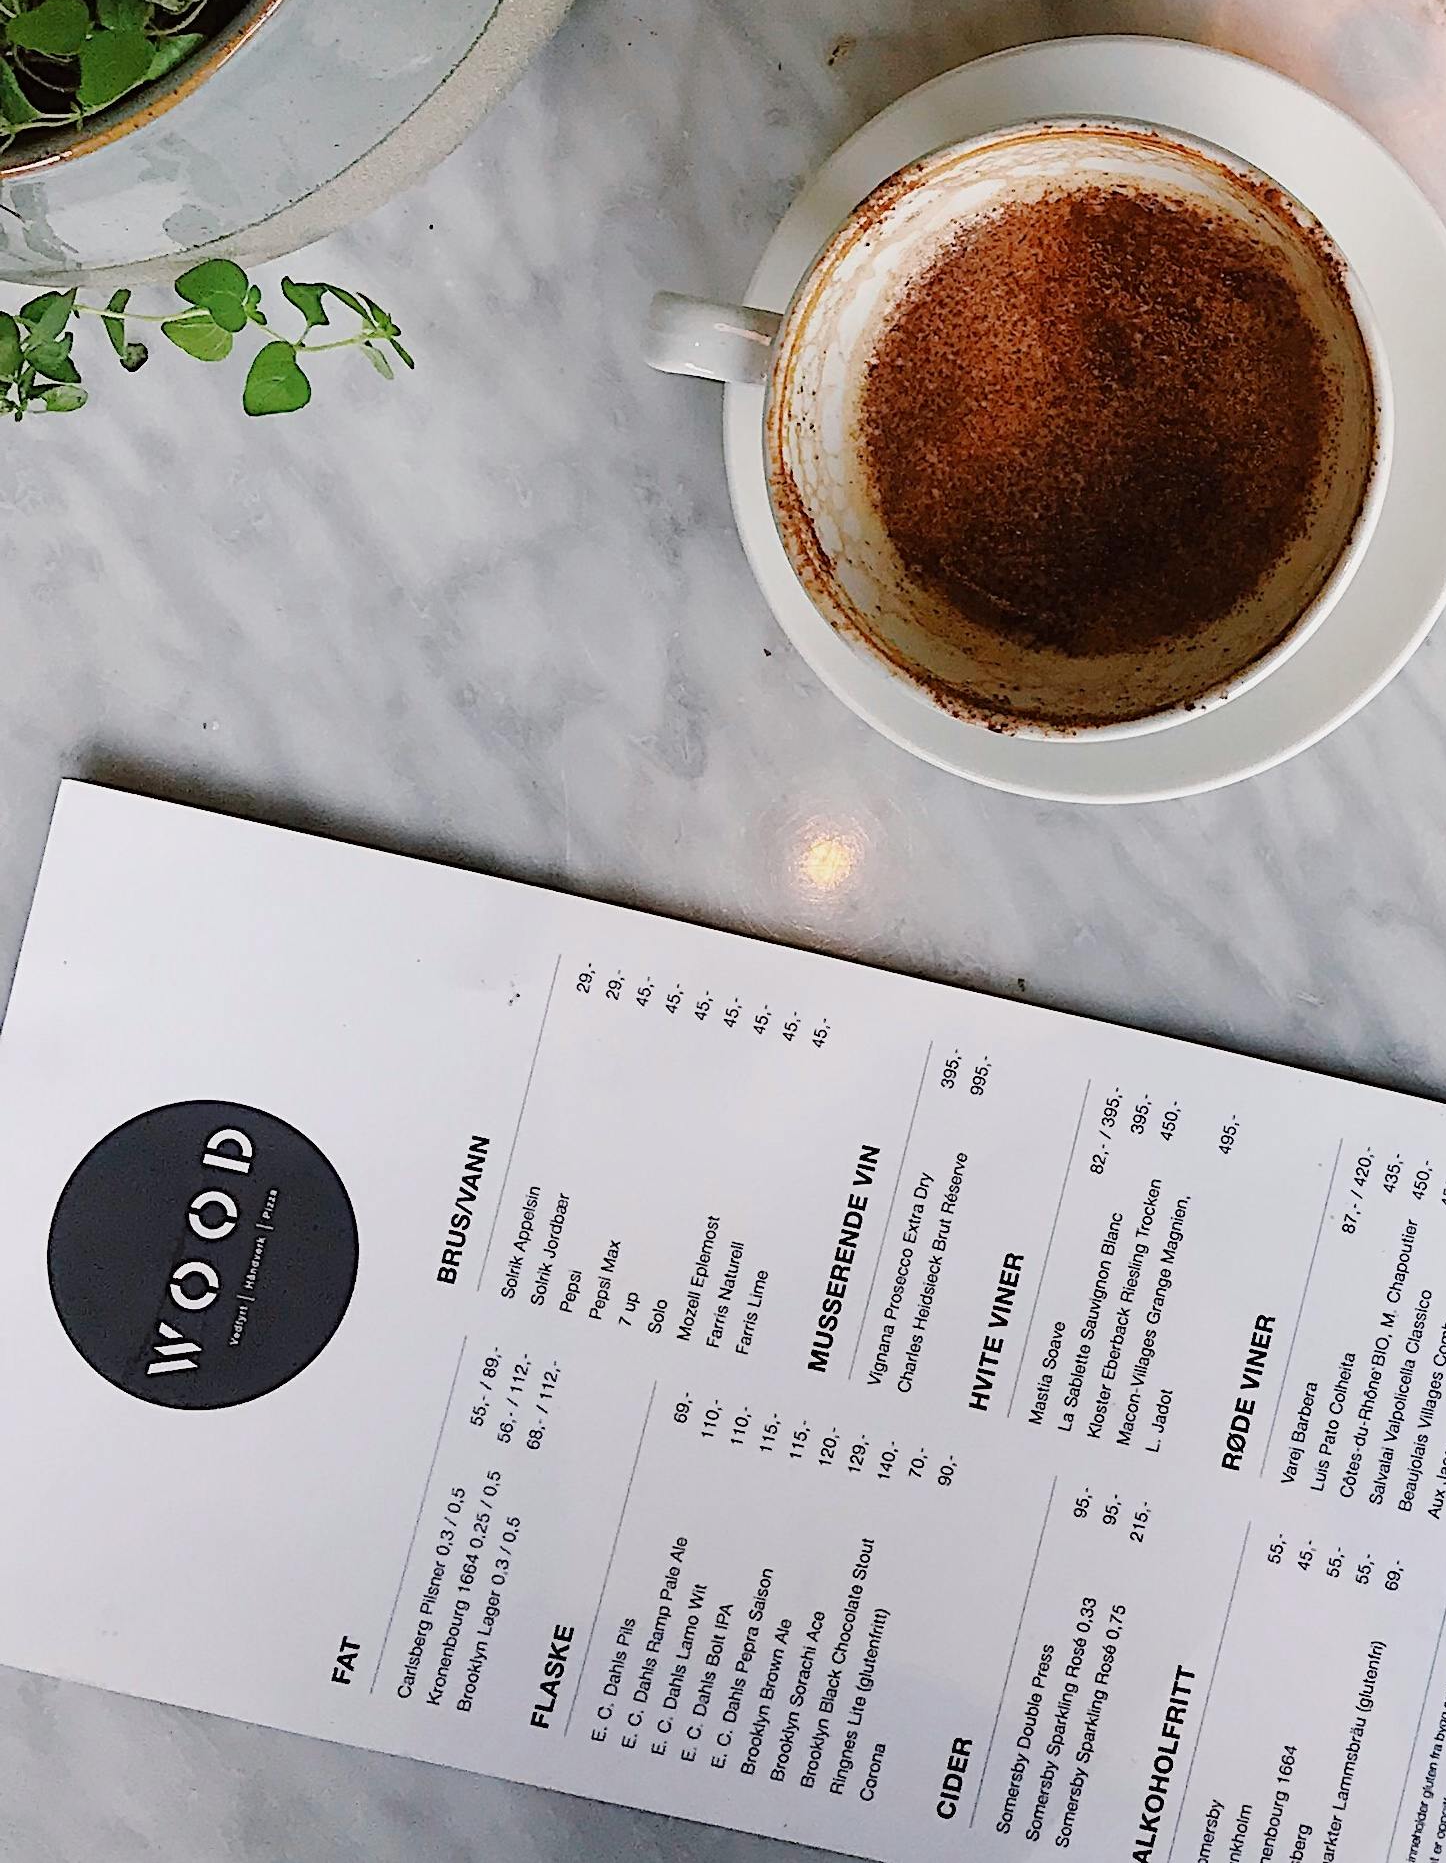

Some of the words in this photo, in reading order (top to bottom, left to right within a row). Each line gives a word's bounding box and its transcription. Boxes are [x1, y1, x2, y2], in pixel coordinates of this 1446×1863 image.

[940, 1048, 962, 1089] 395,-
[970, 1055, 992, 1096] 995,-
[500, 1255, 524, 1299] Solrik
[513, 1186, 541, 1253] Appelsin
[576, 962, 596, 994] 29,-
[559, 1269, 582, 1313] Pepsi
[635, 976, 655, 1007] 45,-
[1353, 1146, 1375, 1187] 420,-
[1383, 1153, 1404, 1194] 435,-
[262, 1190, 277, 1219] Pizza
[436, 1135, 490, 1285] BRUS/VANN
[542, 1192, 570, 1259] Jordbær
[902, 1203, 925, 1244] Extra
[913, 1172, 935, 1200] Dry
[940, 1152, 968, 1215] Réserve
[1341, 1203, 1362, 1235] 87,-
[147, 1129, 252, 1374] WOOD
[600, 1239, 621, 1273] Max
[676, 1291, 701, 1341] Mozell
[690, 1215, 720, 1288] Eplemost
[807, 1193, 869, 1373] MUSSERENDE
[852, 1144, 881, 1186] VIN
[931, 1218, 952, 1252] Brut
[1086, 1383, 1115, 1439] Kloster
[1101, 1307, 1131, 1380] Eberback
[1120, 1243, 1150, 1303] Riesling
[1135, 1178, 1162, 1238] Trocken
[1160, 1101, 1182, 1142] 450,-
[1151, 1389, 1173, 1434] Jadot
[1218, 1114, 1240, 1155] 495,-
[647, 1299, 668, 1334] Solo
[705, 1305, 729, 1348] Farris
[717, 1241, 744, 1301] Naturell
[747, 1270, 769, 1308] Lime
[883, 1248, 914, 1321] Prosecco
[911, 1255, 943, 1331] Heidsieck
[1028, 1374, 1053, 1425] Mastia
[1042, 1321, 1066, 1370] Soave
[1089, 1143, 1109, 1175] 82,-
[1063, 1344, 1091, 1408] Sablette
[1080, 1260, 1112, 1341] Sauvignon
[1100, 1212, 1123, 1256] Blanc
[1116, 1329, 1157, 1446] Macon-Villages
[1146, 1268, 1173, 1325] Grange
[1160, 1196, 1192, 1264] Magnien,
[1371, 1334, 1393, 1367] BIO,
[1386, 1218, 1418, 1304] Chapoutier
[866, 1324, 895, 1385] Vignana
[897, 1334, 924, 1393] Charles
[968, 1335, 1004, 1412] HVITE
[987, 1252, 1025, 1328] VINER
[1383, 1359, 1416, 1442] Valpolicella
[1405, 1289, 1432, 1354] Classico
[1221, 1397, 1256, 1471] RØDE
[1239, 1314, 1276, 1390] VINER
[1290, 1381, 1318, 1443] Barbera
[1329, 1352, 1356, 1415] Colheita
[759, 1413, 782, 1452] 115,-
[908, 1447, 928, 1478] 70,-
[1280, 1446, 1305, 1484] Varej
[1310, 1460, 1330, 1492] Luis
[1318, 1419, 1340, 1456] Pato
[1397, 1434, 1429, 1512] Beaujolais
[1417, 1371, 1444, 1429] Villages
[397, 1619, 434, 1699] Carlsberg
[419, 1560, 446, 1615] Pilsner
[436, 1529, 455, 1556] 0,3
[447, 1487, 466, 1514] 0,5
[469, 1395, 490, 1427] 55,-
[482, 1347, 502, 1379] 89,-
[426, 1599, 471, 1706] Kronenbourg
[457, 1554, 480, 1592] 1664
[469, 1513, 490, 1549] 0,25
[496, 1412, 518, 1444] 56,-
[509, 1353, 532, 1392] 112,-
[456, 1641, 488, 1713] Brooklyn
[476, 1589, 501, 1636] Lager
[526, 1419, 546, 1450] 68,-
[602, 1651, 627, 1697] Dahls
[616, 1618, 636, 1647] Pils
[673, 1392, 693, 1424] 69,-
[645, 1605, 672, 1653] Ramp
[670, 1537, 688, 1564] Ale
[701, 1399, 723, 1437] 110,-
[1297, 1540, 1317, 1571] 45,-
[714, 1604, 734, 1630] IPA
[740, 1704, 771, 1776] Brooklyn
[759, 1648, 785, 1702] Brown
[818, 1427, 840, 1466] 120,-
[789, 1645, 817, 1708] Sorachi
[847, 1434, 870, 1473] 129,-
[818, 1669, 843, 1714] Black
[831, 1584, 864, 1665] Chocolate
[852, 1538, 875, 1581] Stout
[877, 1441, 899, 1479] 140,-
[1105, 1604, 1126, 1640] 0,75
[1129, 1501, 1152, 1543] 215,-
[331, 1635, 361, 1685] FAT
[705, 1634, 726, 1667] Bolt
[735, 1626, 760, 1674] Pepra
[748, 1568, 774, 1622] Saison
[855, 1608, 891, 1692] (glutenfritt)
[859, 1743, 886, 1802] Corona
[937, 1455, 958, 1487] 90,-
[995, 1751, 1030, 1835] Somersby
[1016, 1692, 1043, 1750] Double
[1031, 1644, 1055, 1689] Press
[1073, 1487, 1093, 1518] 95,-
[529, 1624, 575, 1729] FLASKE
[846, 1696, 867, 1726] Lite
[1025, 1760, 1060, 1842] Somersby
[1046, 1682, 1079, 1757] Sparkling
[1065, 1637, 1087, 1679] Rosé
[1076, 1597, 1097, 1633] 0,33
[1331, 1716, 1367, 1811] Lammsbräu
[1355, 1641, 1387, 1713] (glutenfri)
[1384, 1560, 1404, 1591] 69,-
[829, 1730, 858, 1795] Ringnes
[936, 1737, 973, 1820] CIDER
[1132, 1664, 1195, 1863] ALKOHOLFRITT
